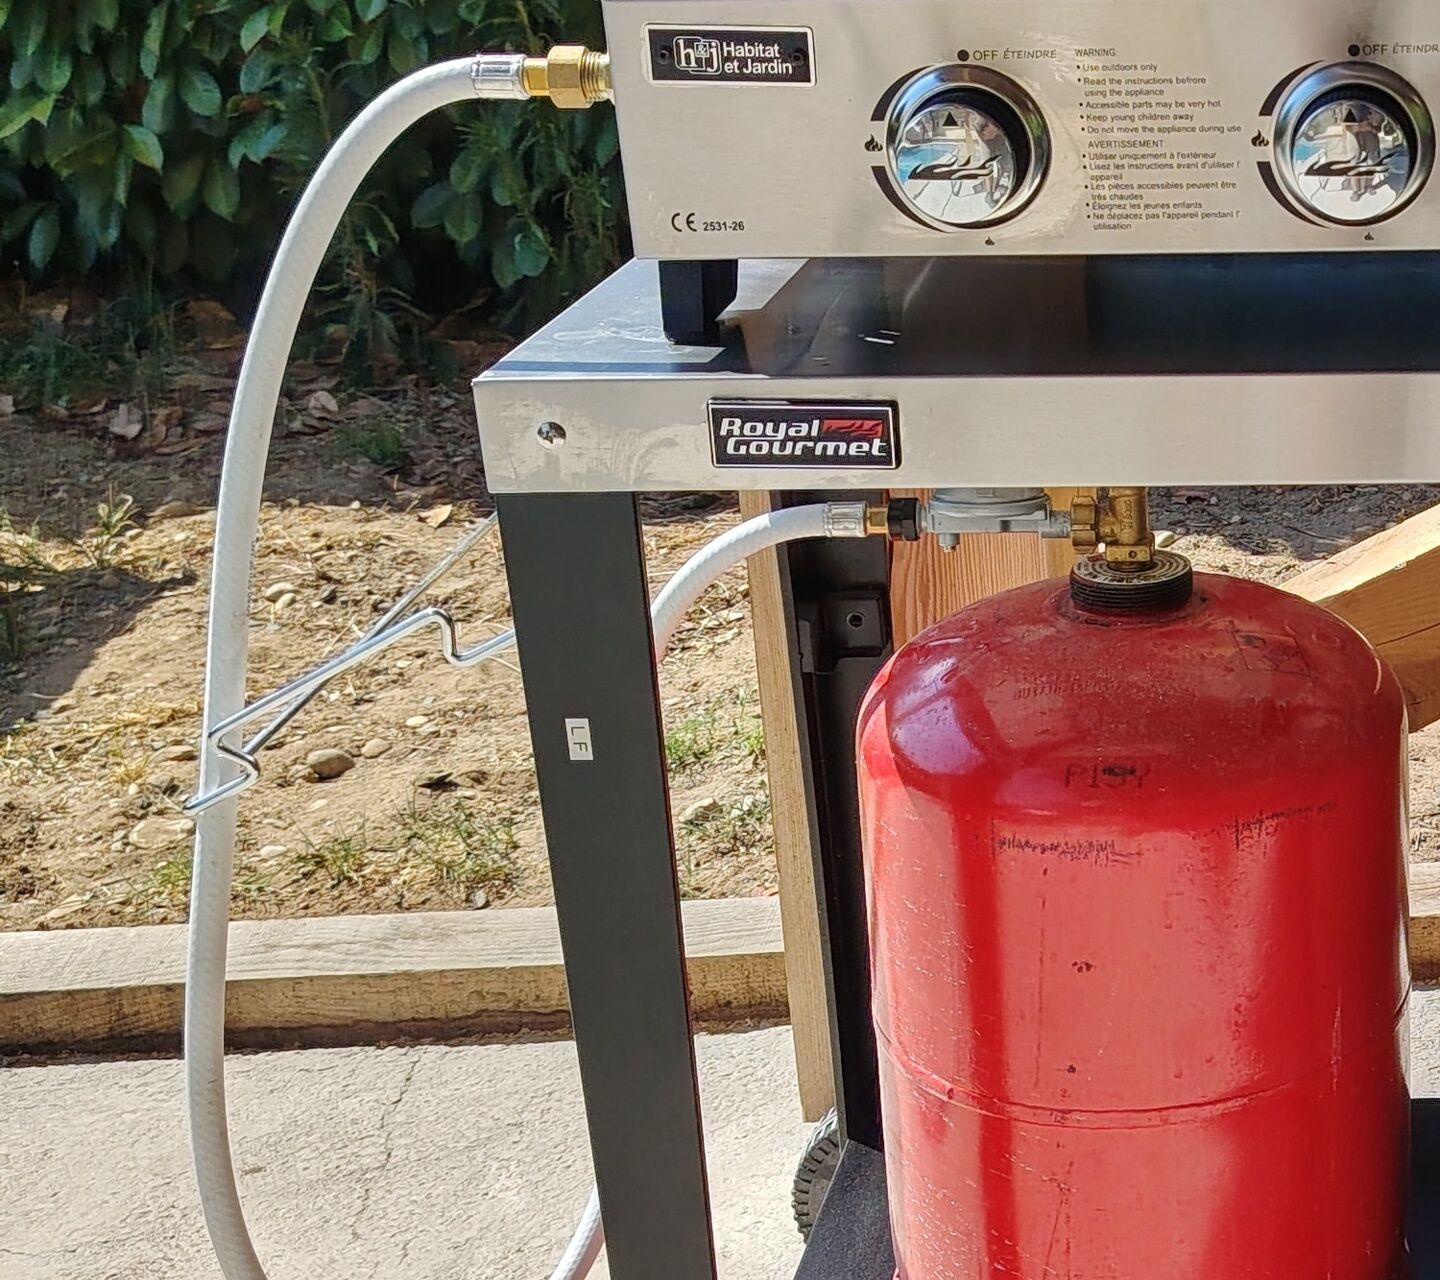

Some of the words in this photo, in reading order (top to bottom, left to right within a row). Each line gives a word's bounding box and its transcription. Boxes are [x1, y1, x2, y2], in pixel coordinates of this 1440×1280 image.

[723, 41, 780, 58] Habitat
[973, 50, 999, 60] OFF
[1003, 48, 1056, 59] ÉTEINDRE
[1362, 44, 1388, 55] OFF
[724, 61, 740, 73] et
[743, 59, 793, 75] Jardin
[672, 212, 697, 232] CE
[703, 221, 744, 231] 2531-26
[719, 418, 820, 440] Royal
[726, 438, 888, 456] Gourmet
